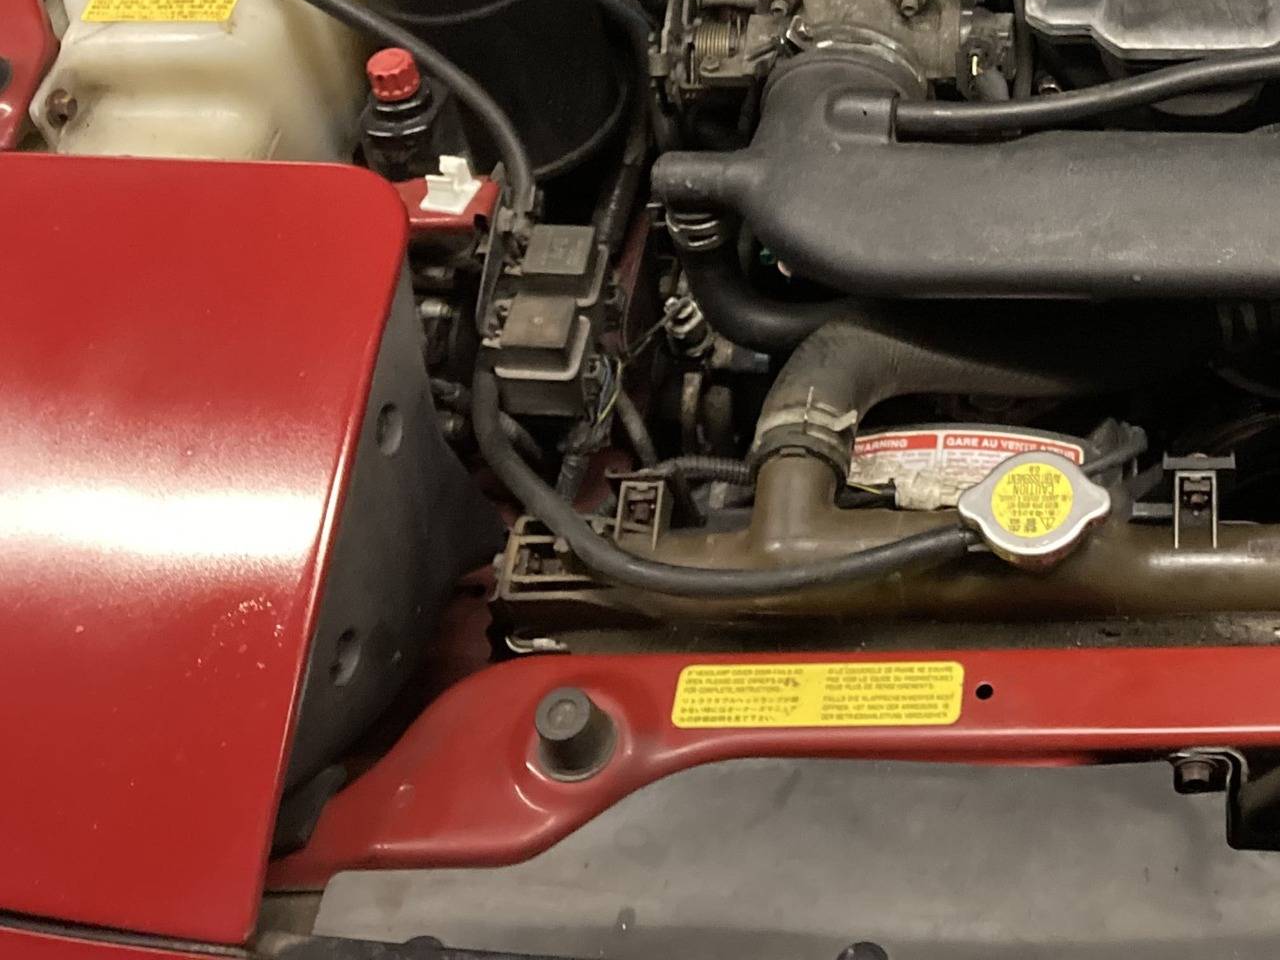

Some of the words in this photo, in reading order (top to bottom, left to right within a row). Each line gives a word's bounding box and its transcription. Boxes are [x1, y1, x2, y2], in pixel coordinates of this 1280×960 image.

[855, 438, 908, 452] WARNING
[946, 437, 978, 447] GARE
[982, 439, 998, 448] AU
[1013, 480, 1055, 496] CAUTION
